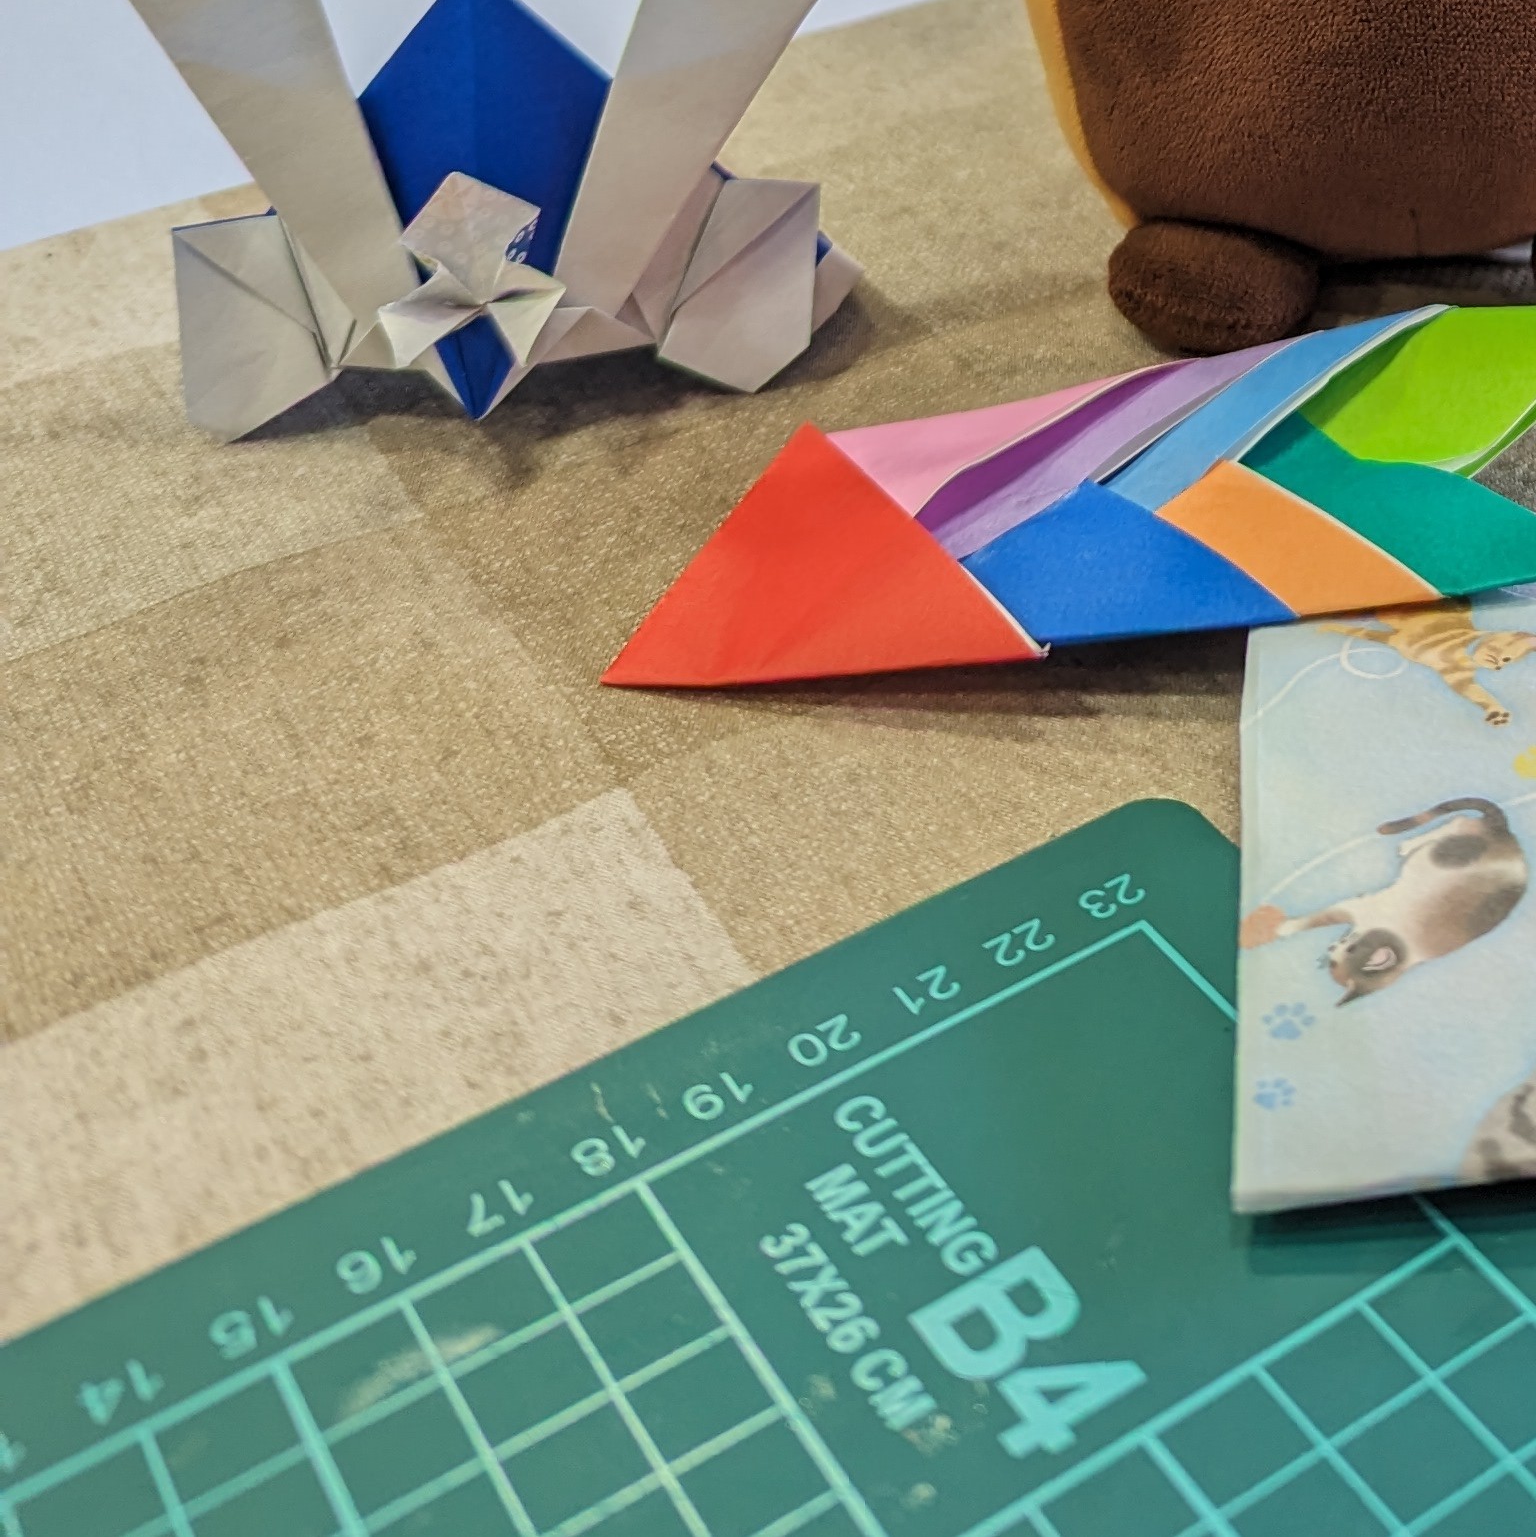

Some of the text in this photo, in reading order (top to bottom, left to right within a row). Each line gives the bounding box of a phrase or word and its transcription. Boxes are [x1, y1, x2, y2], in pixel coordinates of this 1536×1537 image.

[1078, 873, 1147, 919] 23
[981, 918, 1056, 967] 22
[892, 964, 961, 1015] 21
[787, 1013, 862, 1067] 20
[682, 1071, 755, 1121] 19
[570, 1125, 646, 1176] 18
[467, 1179, 534, 1238] 17
[805, 1163, 910, 1257] MAT
[834, 1095, 998, 1275] CUTTING
[336, 1236, 417, 1294] 16
[210, 1296, 293, 1358] 15
[759, 1221, 937, 1431] 37X26 CM
[907, 1245, 1147, 1457] B4
[78, 1359, 164, 1425] 14
